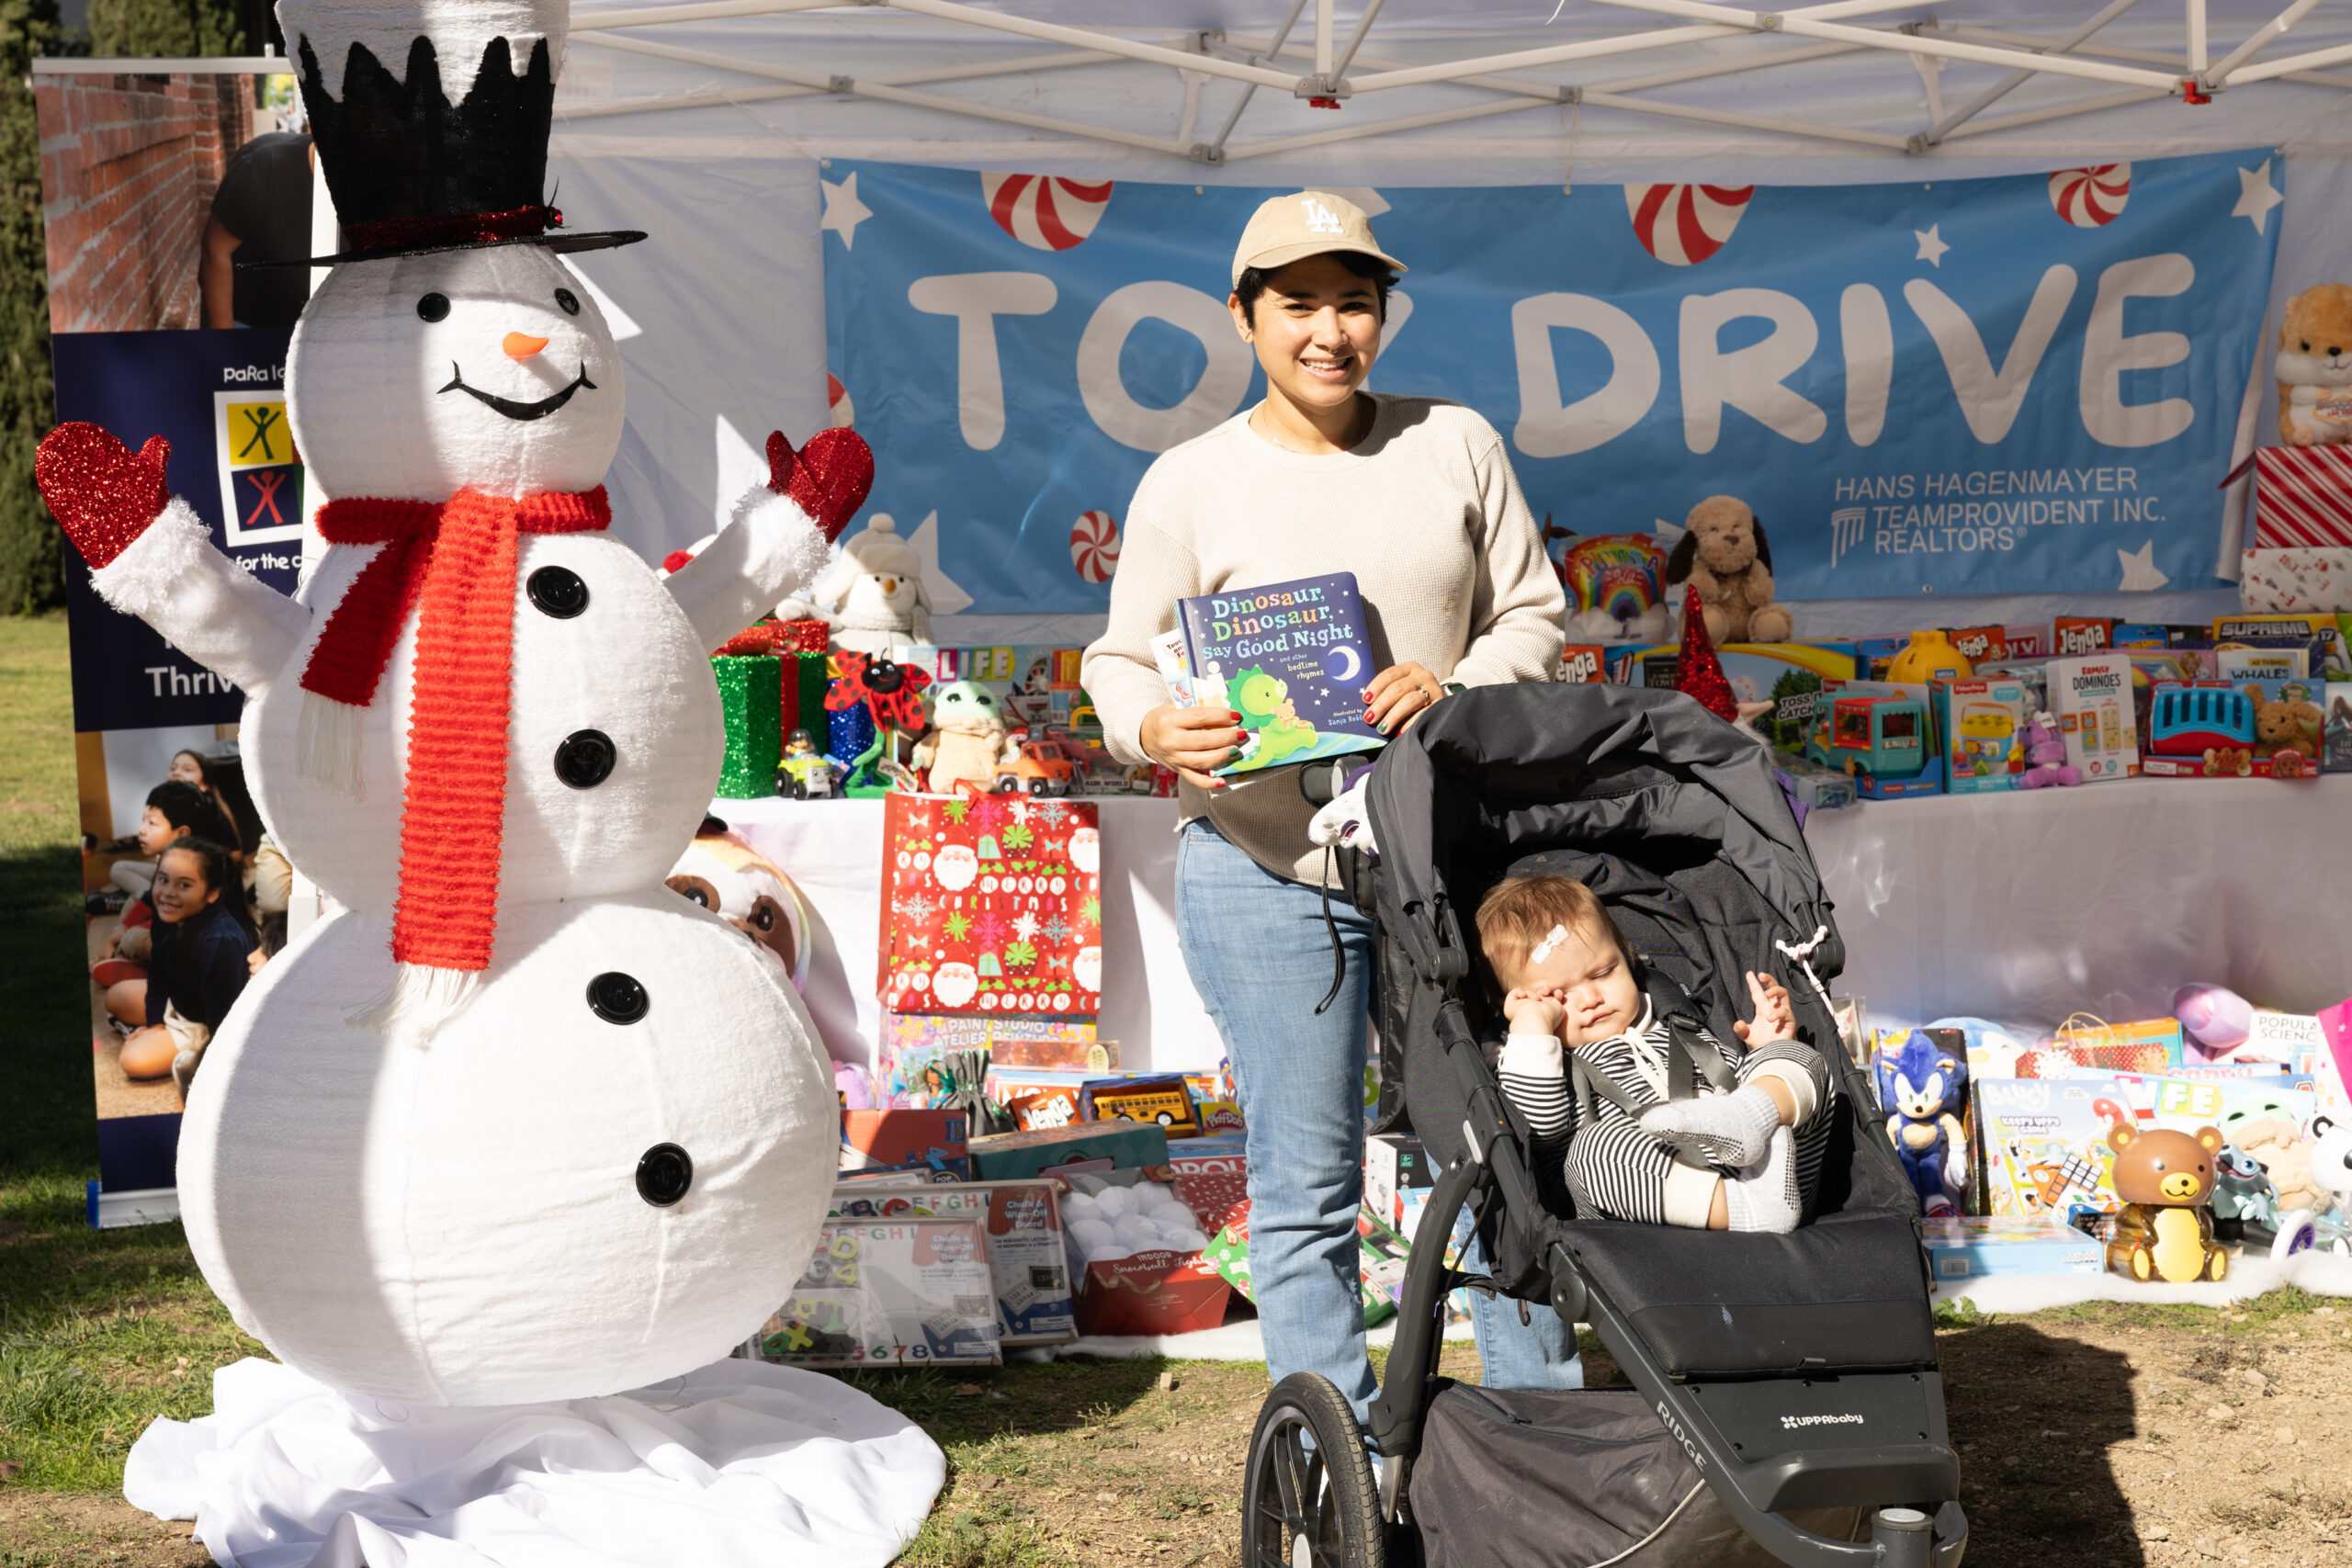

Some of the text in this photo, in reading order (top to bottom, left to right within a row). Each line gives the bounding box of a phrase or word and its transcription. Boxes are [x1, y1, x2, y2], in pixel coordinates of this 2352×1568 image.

[1301, 198, 1344, 234] LA
[1511, 252, 2194, 459] DRIVE
[1835, 467, 2137, 502] HANS HAGENMAYER
[1872, 496, 2165, 529] TEAMPROVIDENT INC.
[257, 551, 289, 570] the
[1211, 586, 1326, 619] Dinosaur,
[1212, 604, 1334, 642] Dinosaur,
[2221, 621, 2311, 637] SUPREME
[1236, 631, 1290, 659] Good
[1294, 623, 1353, 649] Night
[2060, 624, 2106, 655] Jenga
[2321, 630, 2334, 641] 17
[1166, 638, 1182, 650] Touc
[1173, 645, 1183, 654] an
[1957, 634, 1989, 658] Jenga
[940, 650, 1009, 680] LIFE
[1279, 652, 1307, 663] and other
[1287, 660, 1318, 672] bedtime
[1556, 651, 1598, 683] enga
[2081, 665, 2110, 676] FAMILY
[144, 665, 235, 697] Thriv
[1296, 668, 1325, 681] rhymes
[2073, 672, 2121, 691] DOMINOES
[2231, 668, 2290, 680] WHALES
[1781, 694, 1811, 708] TOSS
[1779, 705, 1815, 721] CATCH
[1328, 717, 1347, 727] Sanja
[939, 894, 1068, 911] CHRISTMAS
[947, 1019, 1046, 1034] PAINT STUDIO
[2259, 1016, 2316, 1031] POPULA
[933, 1031, 988, 1047] ATELIER
[2260, 1028, 2316, 1043] SCIENC
[2143, 1079, 2215, 1115] IFE
[1020, 1094, 1075, 1130] Jenga
[1206, 1111, 1243, 1128] Play-Doh
[2000, 1115, 2061, 1127] KEEPY UPPY
[2018, 1125, 2050, 1135] GAME
[930, 1196, 942, 1210] F
[946, 1194, 961, 1210] G
[964, 1193, 978, 1208] H
[1006, 1199, 1034, 1209] Chalk
[1005, 1208, 1048, 1220] Wipe-Off
[1014, 1219, 1044, 1229] Board
[871, 1227, 887, 1241] G
[889, 1226, 903, 1240] H
[932, 1234, 961, 1243] Chalk
[930, 1242, 976, 1253] Wipe-Off
[940, 1251, 971, 1262] Board
[1136, 1251, 1172, 1261] INDOOR
[1113, 1254, 1206, 1274] Snowball Fight
[871, 1345, 888, 1359] 6
[892, 1345, 908, 1359] 7
[911, 1344, 929, 1359] 8
[1796, 1413, 1864, 1427] UPPAbaby
[1657, 1400, 1707, 1472] RIDGE
